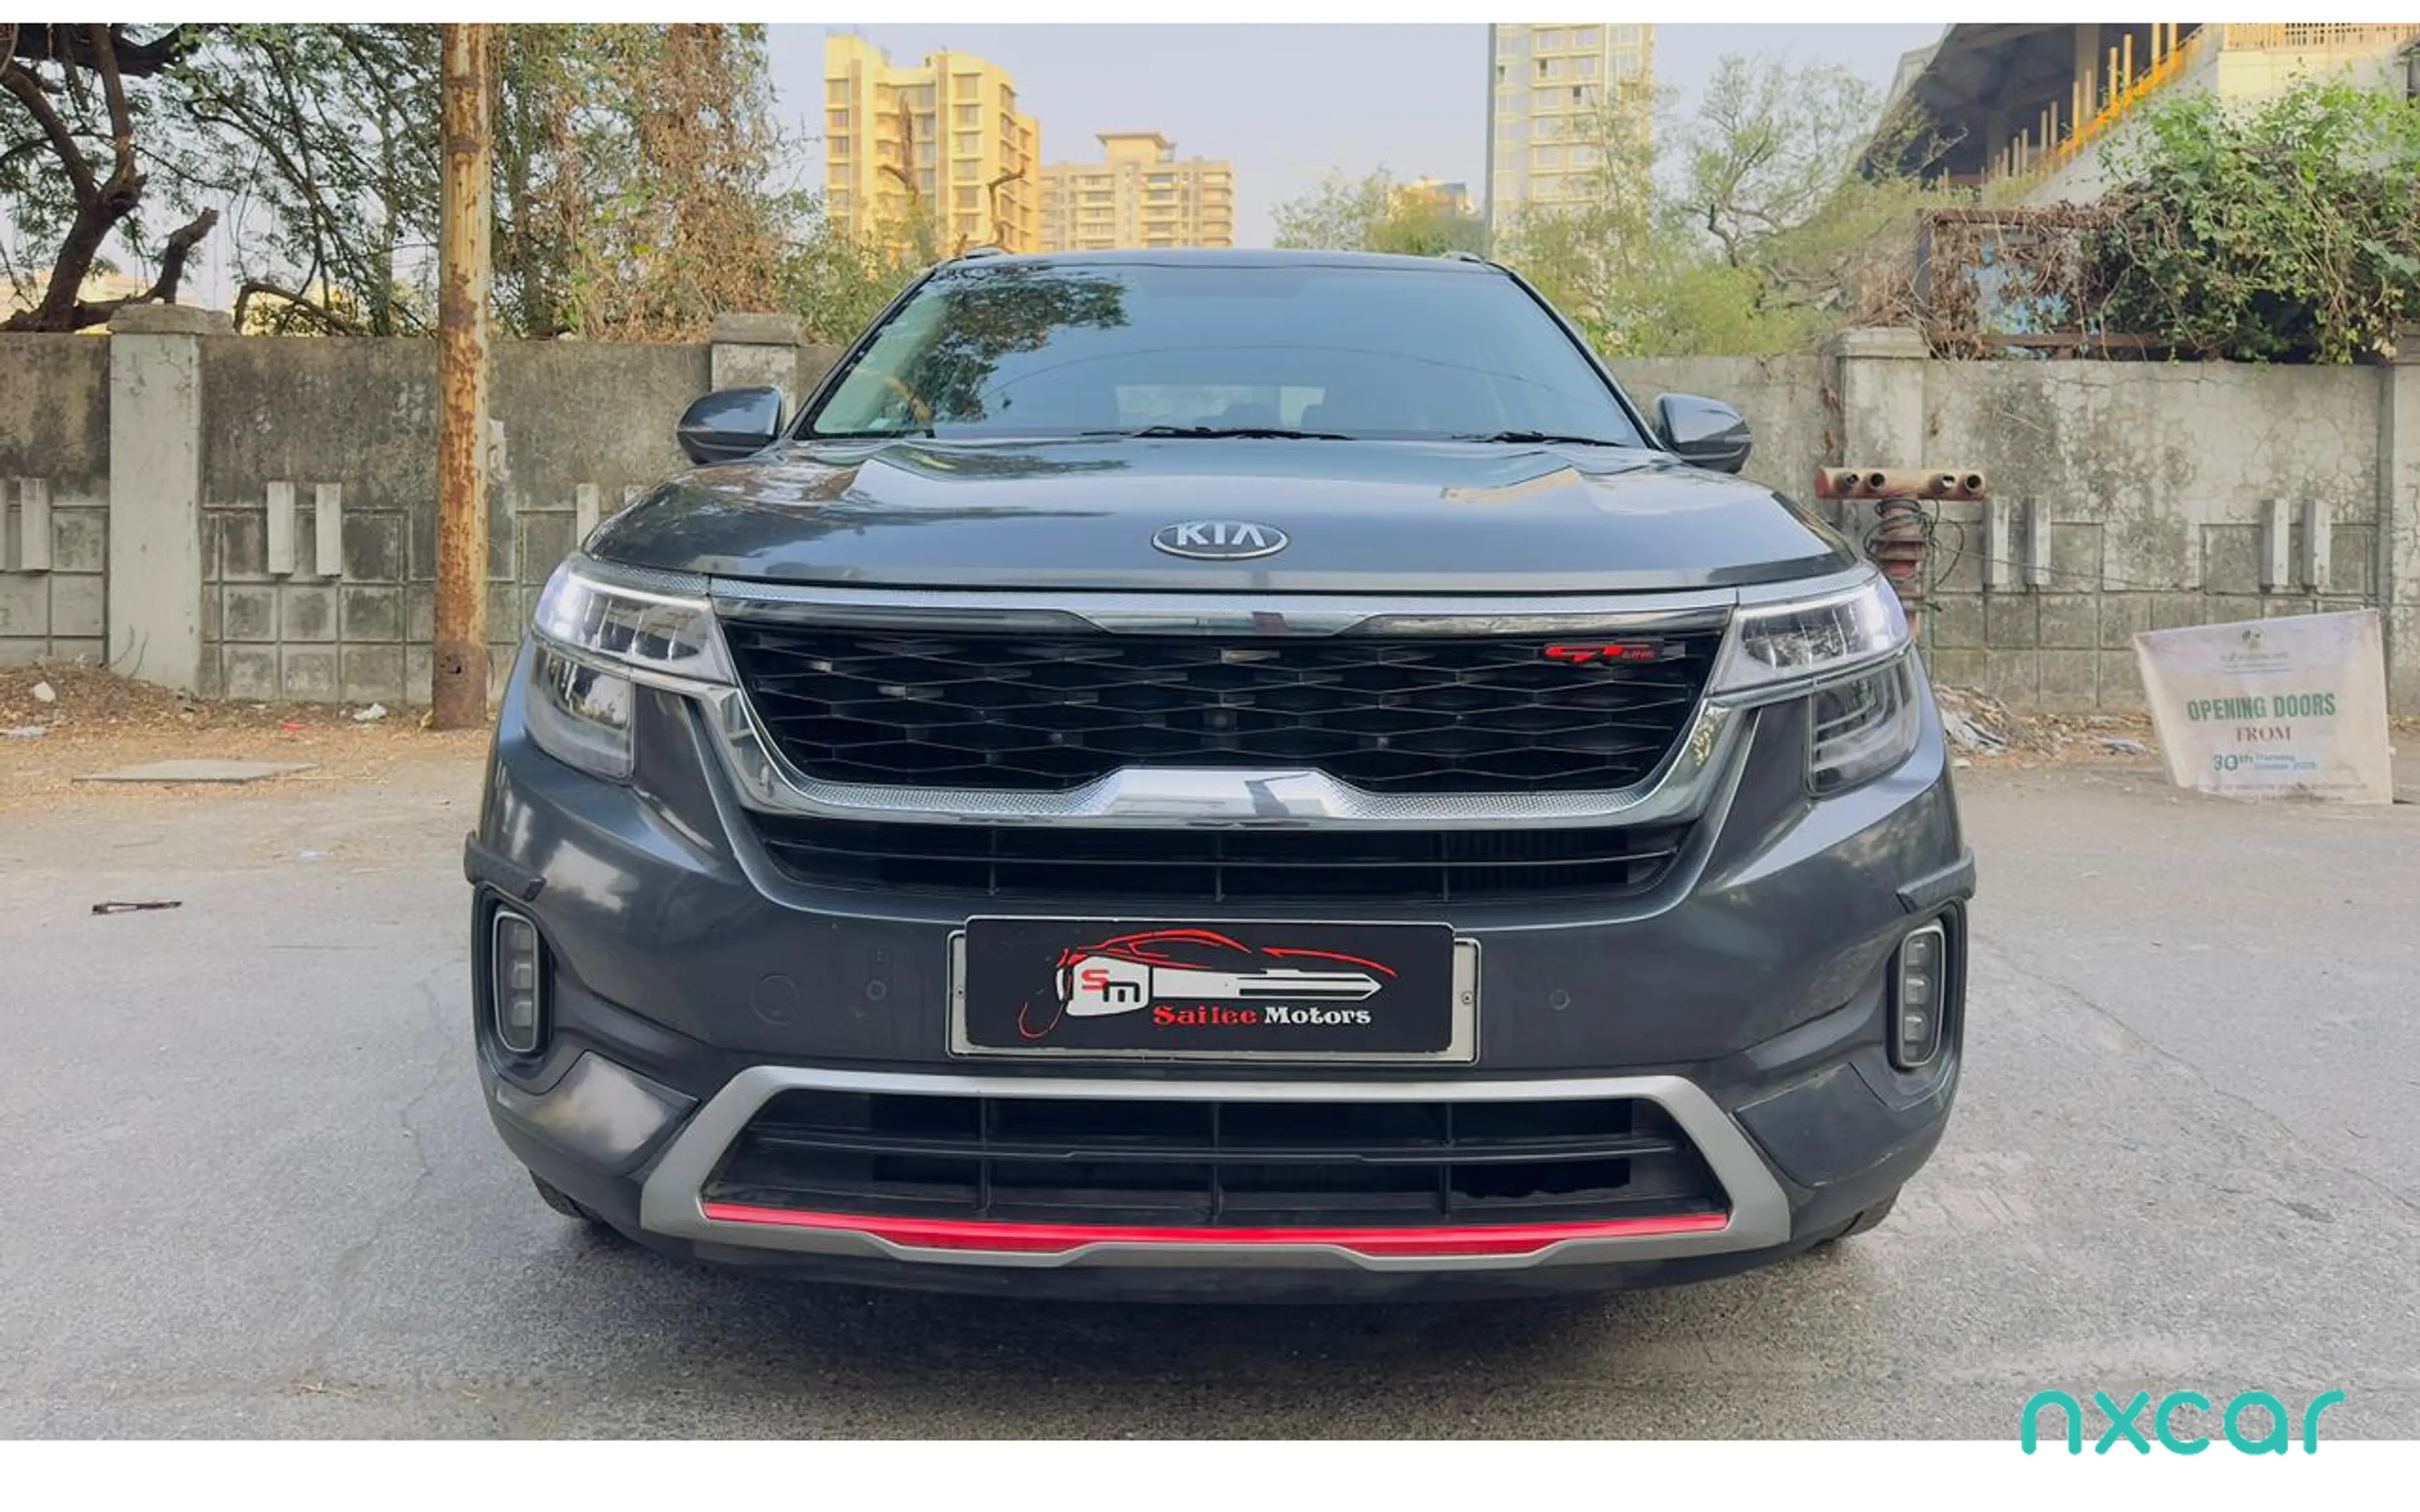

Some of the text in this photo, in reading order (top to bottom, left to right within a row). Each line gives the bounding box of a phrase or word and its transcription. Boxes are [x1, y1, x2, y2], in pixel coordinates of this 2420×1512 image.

[1177, 523, 1265, 547] KIA
[2187, 693, 2336, 721] OPENING DOORS
[2237, 726, 2292, 742] FROM
[1264, 1006, 1371, 1024] Motors
